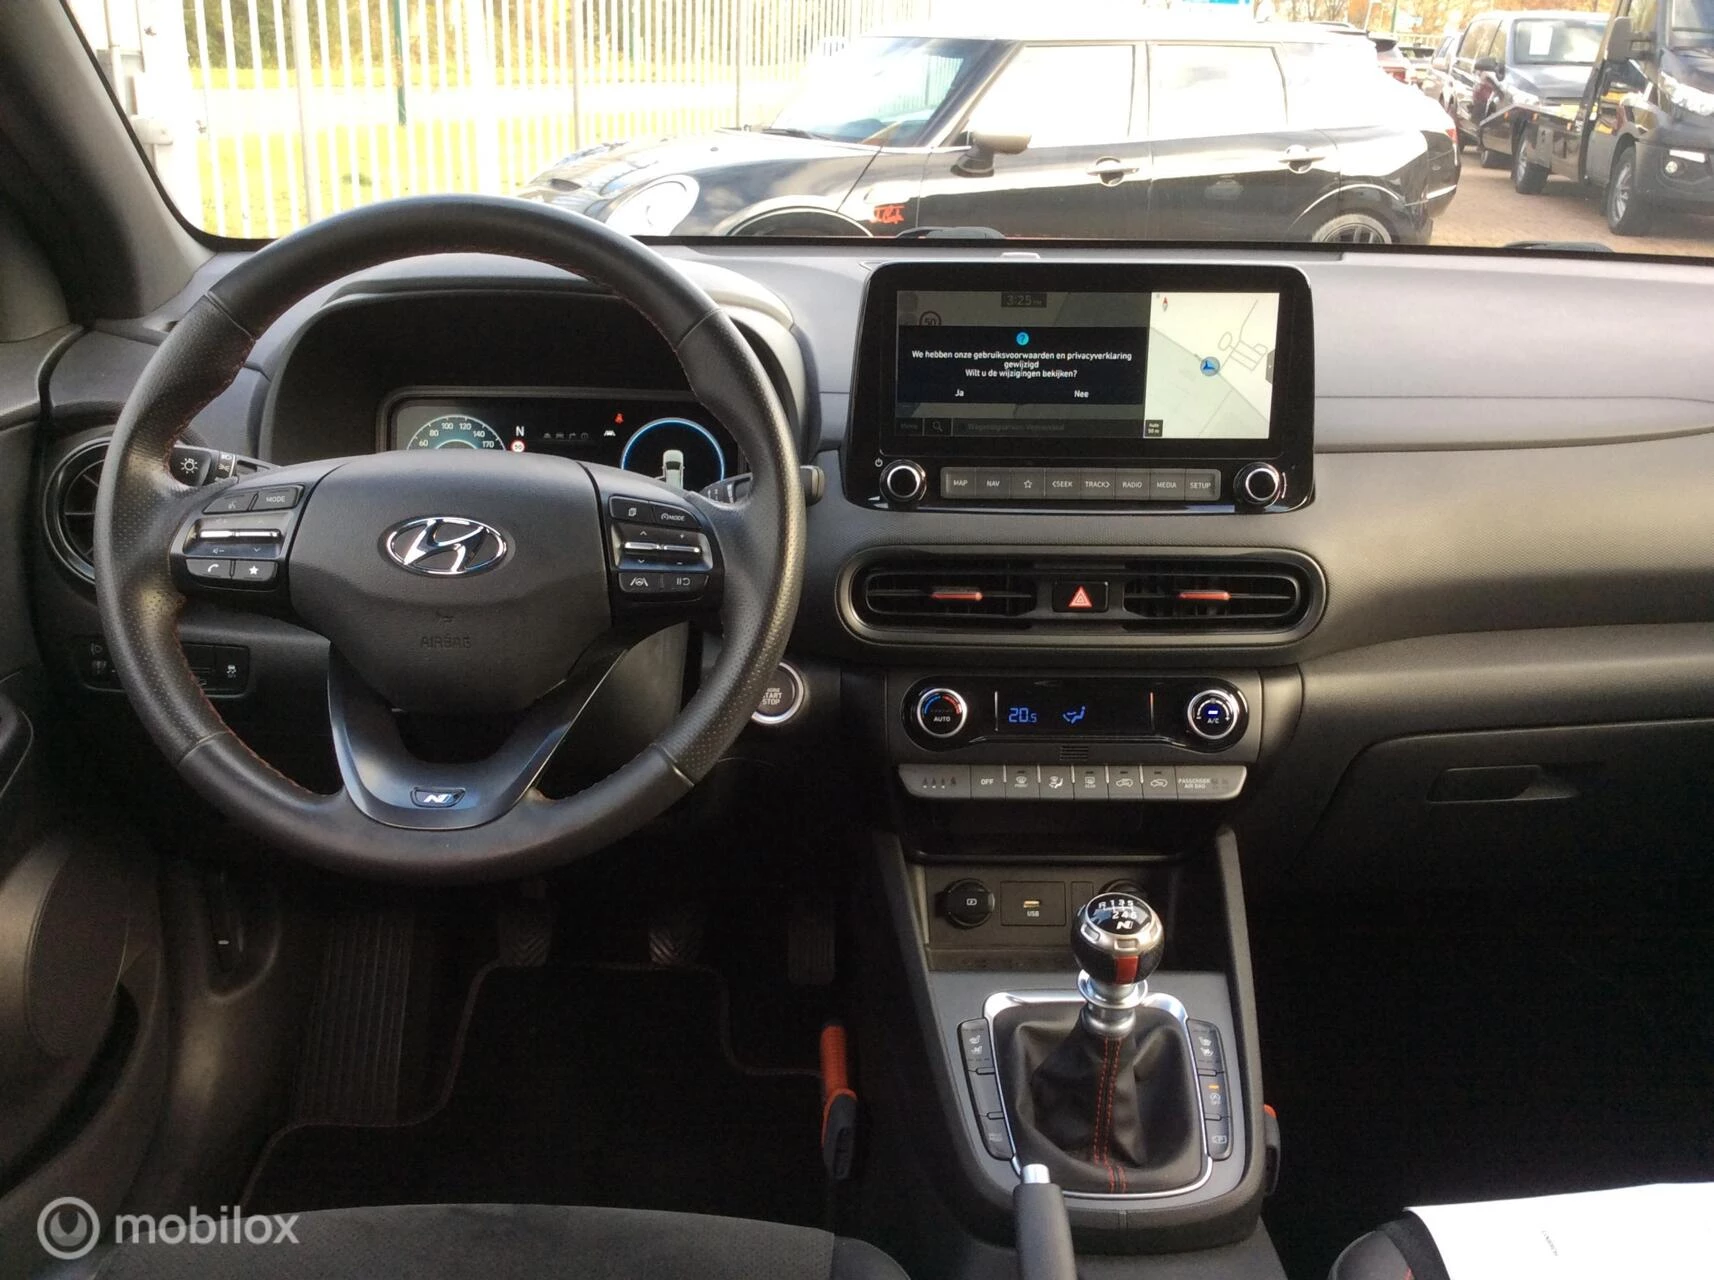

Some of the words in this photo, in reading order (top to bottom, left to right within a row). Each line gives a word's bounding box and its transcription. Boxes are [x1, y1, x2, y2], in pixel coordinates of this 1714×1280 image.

[911, 351, 924, 359] We
[925, 350, 953, 359] hebben
[973, 351, 1055, 361] gebruiksvoorwaarden
[1067, 351, 1133, 361] privacyverklaring
[1003, 361, 1040, 370] gewijzigd
[965, 369, 980, 377] Wilt
[988, 369, 998, 377] de
[999, 369, 1041, 379] wijzigingen
[1042, 369, 1078, 379] bekijken?
[954, 389, 965, 397] Ja
[1074, 390, 1089, 398] Nee
[441, 422, 453, 430] 100
[459, 422, 471, 430] 120
[516, 426, 525, 436] N
[986, 480, 1000, 488] NAV
[1122, 480, 1143, 489] RADIO
[1156, 480, 1177, 489] MEDIA
[1190, 481, 1212, 490] SETUP
[266, 495, 286, 504] MODE
[420, 635, 473, 649] AIRBAG
[933, 715, 951, 723] AUTO
[1206, 717, 1220, 725] A/C
[980, 778, 994, 786] OFF
